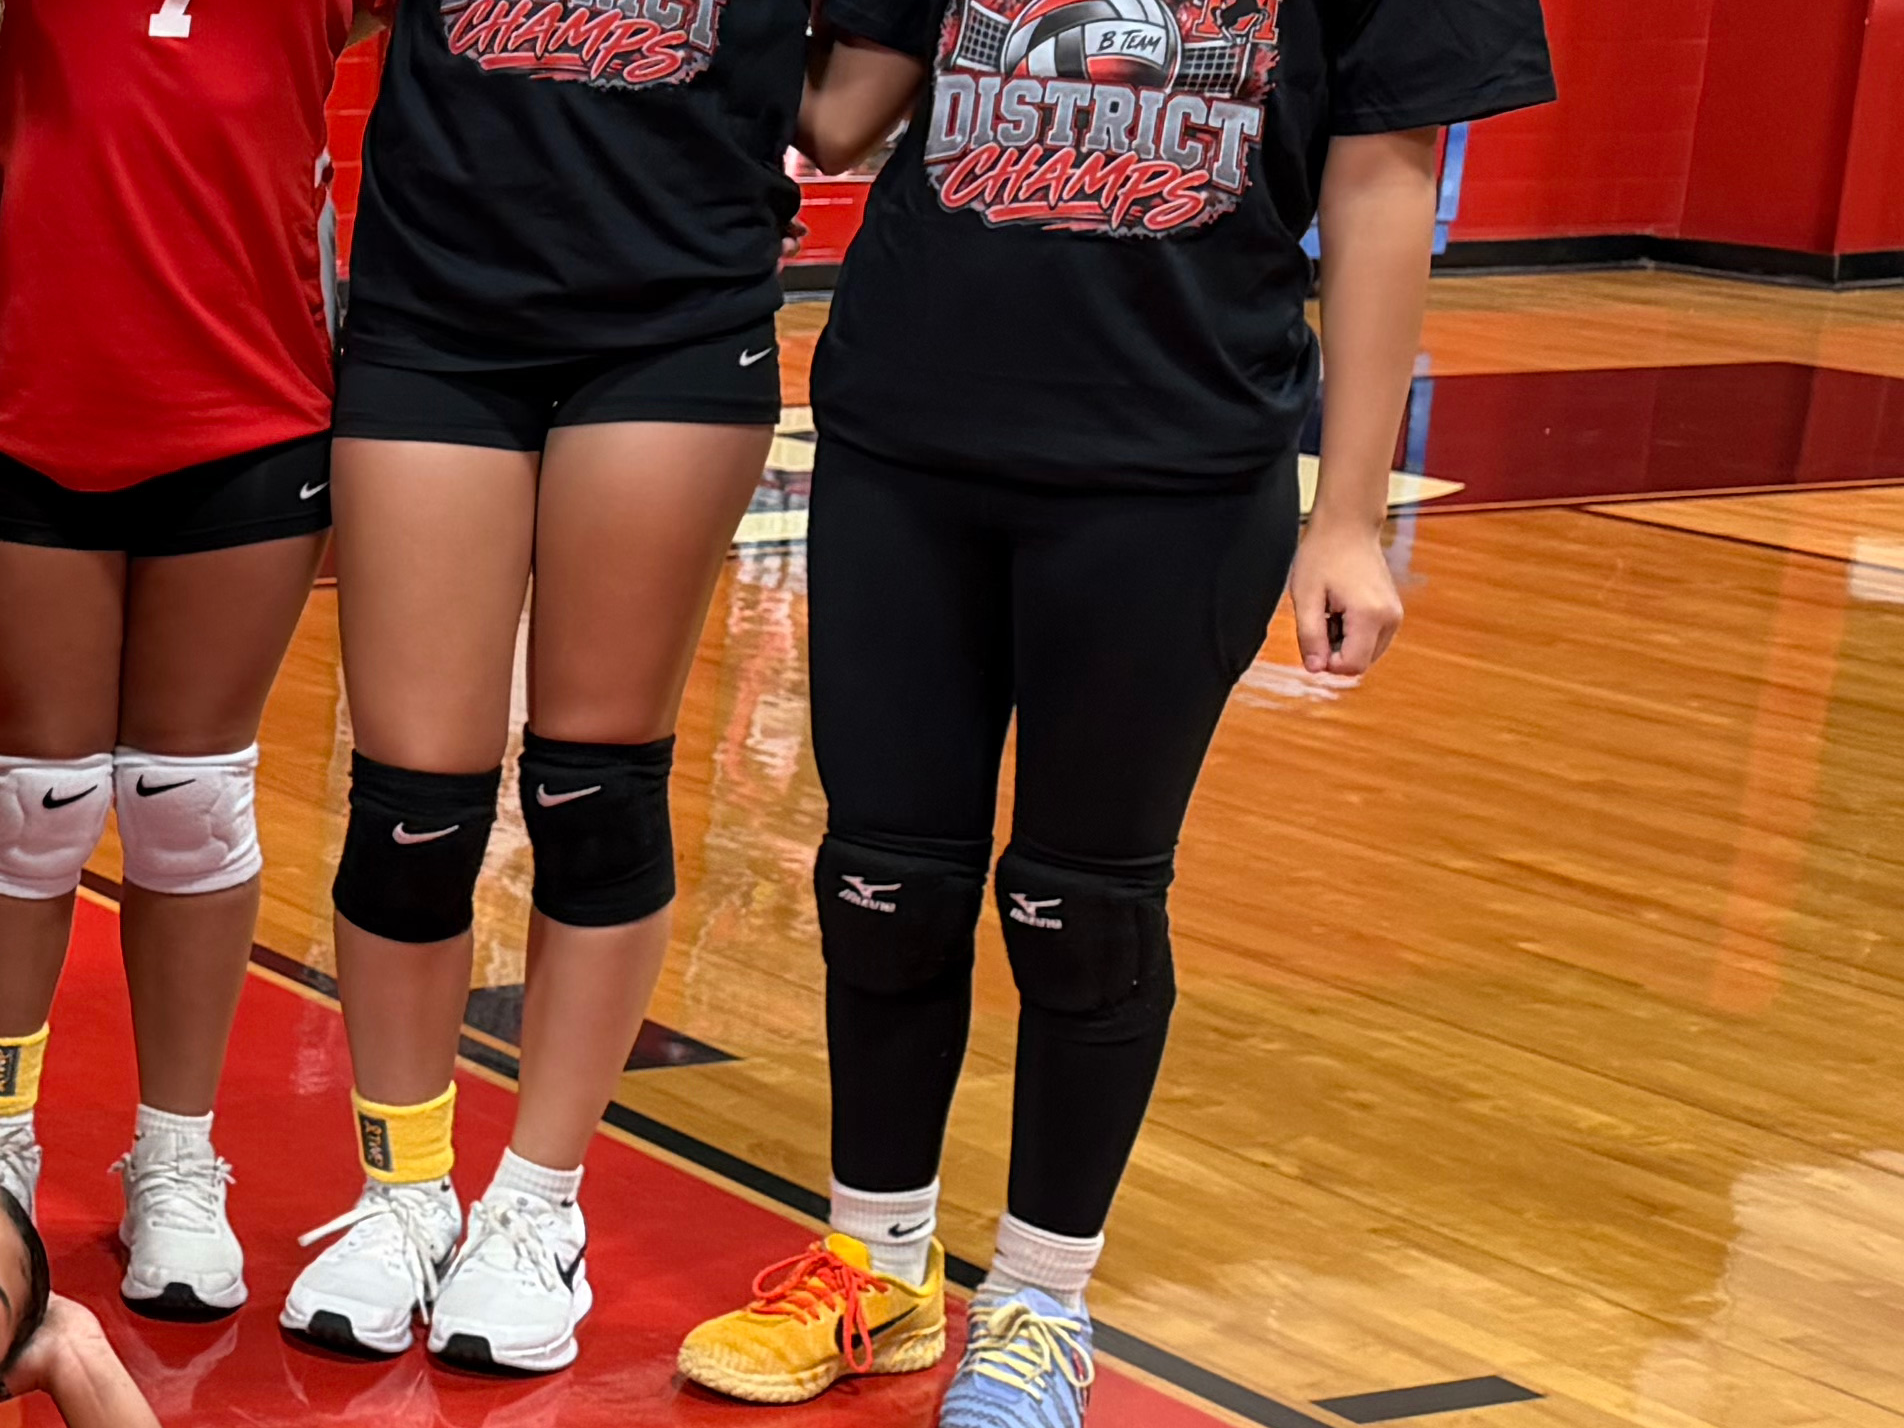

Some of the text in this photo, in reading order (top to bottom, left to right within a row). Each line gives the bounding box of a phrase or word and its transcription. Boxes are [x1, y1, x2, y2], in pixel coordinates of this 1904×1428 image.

[1097, 30, 1162, 54] B TEAM
[925, 73, 1266, 194] DISTRICT
[940, 145, 1211, 232] CHAMPS
